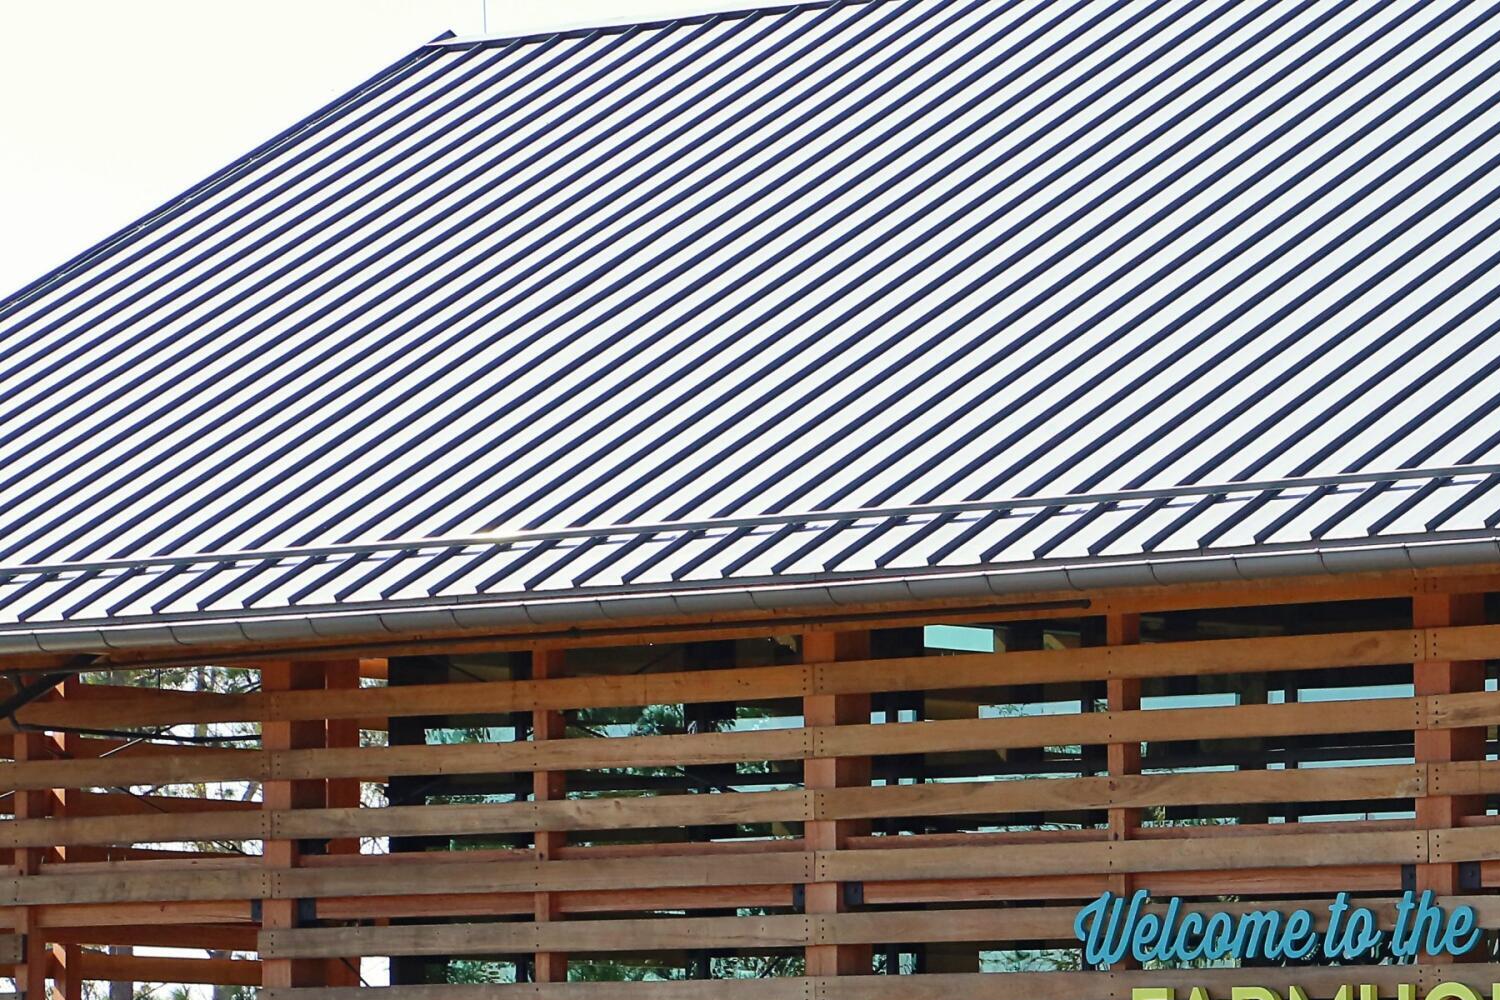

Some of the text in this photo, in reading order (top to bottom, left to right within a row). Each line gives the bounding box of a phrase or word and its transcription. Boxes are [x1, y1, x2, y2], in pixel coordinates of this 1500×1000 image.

[1073, 889, 1482, 965] Welcome to the
